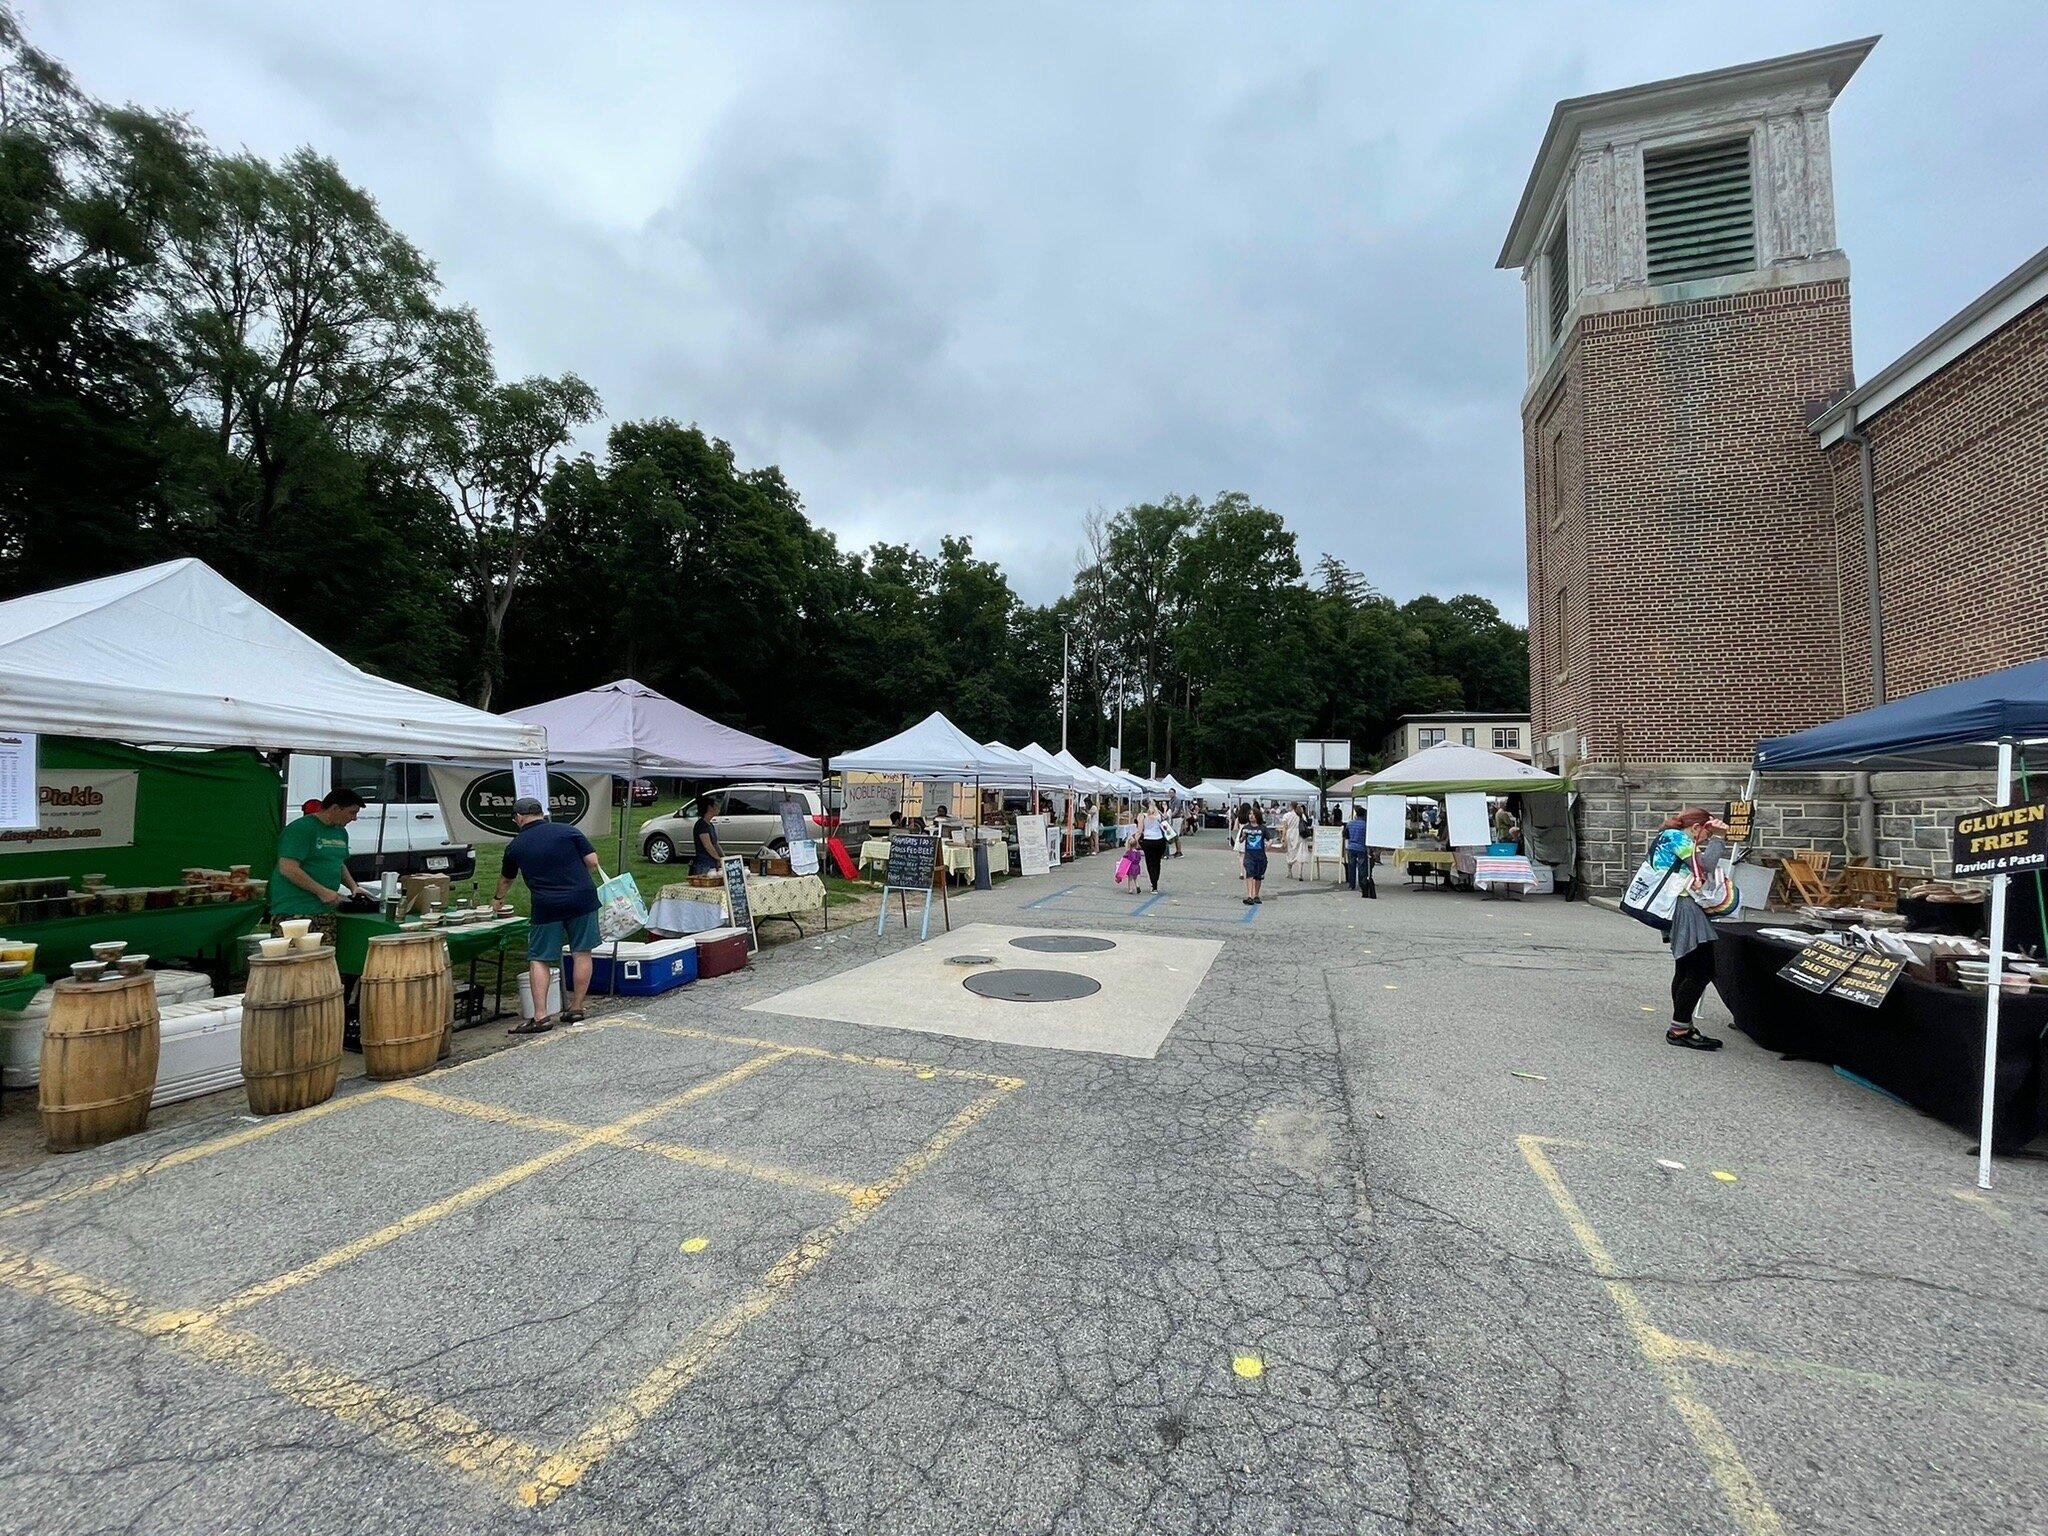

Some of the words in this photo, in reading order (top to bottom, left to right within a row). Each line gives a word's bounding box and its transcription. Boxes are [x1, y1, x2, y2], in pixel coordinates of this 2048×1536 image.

[39, 786, 104, 806] Pickle
[479, 792, 577, 807] Farats
[849, 785, 875, 802] NOBLE
[1958, 804, 2045, 834] GLUTEN
[1970, 829, 2028, 853] FREE
[1955, 859, 1995, 874] Ravioli
[1997, 857, 2007, 868] &
[2009, 853, 2045, 867] Pasta
[1813, 940, 1843, 955] FREE
[1800, 959, 1832, 977] PASTA
[1802, 948, 1815, 959] OF
[1815, 951, 1852, 970] FRESH
[1880, 958, 1899, 971] Dry
